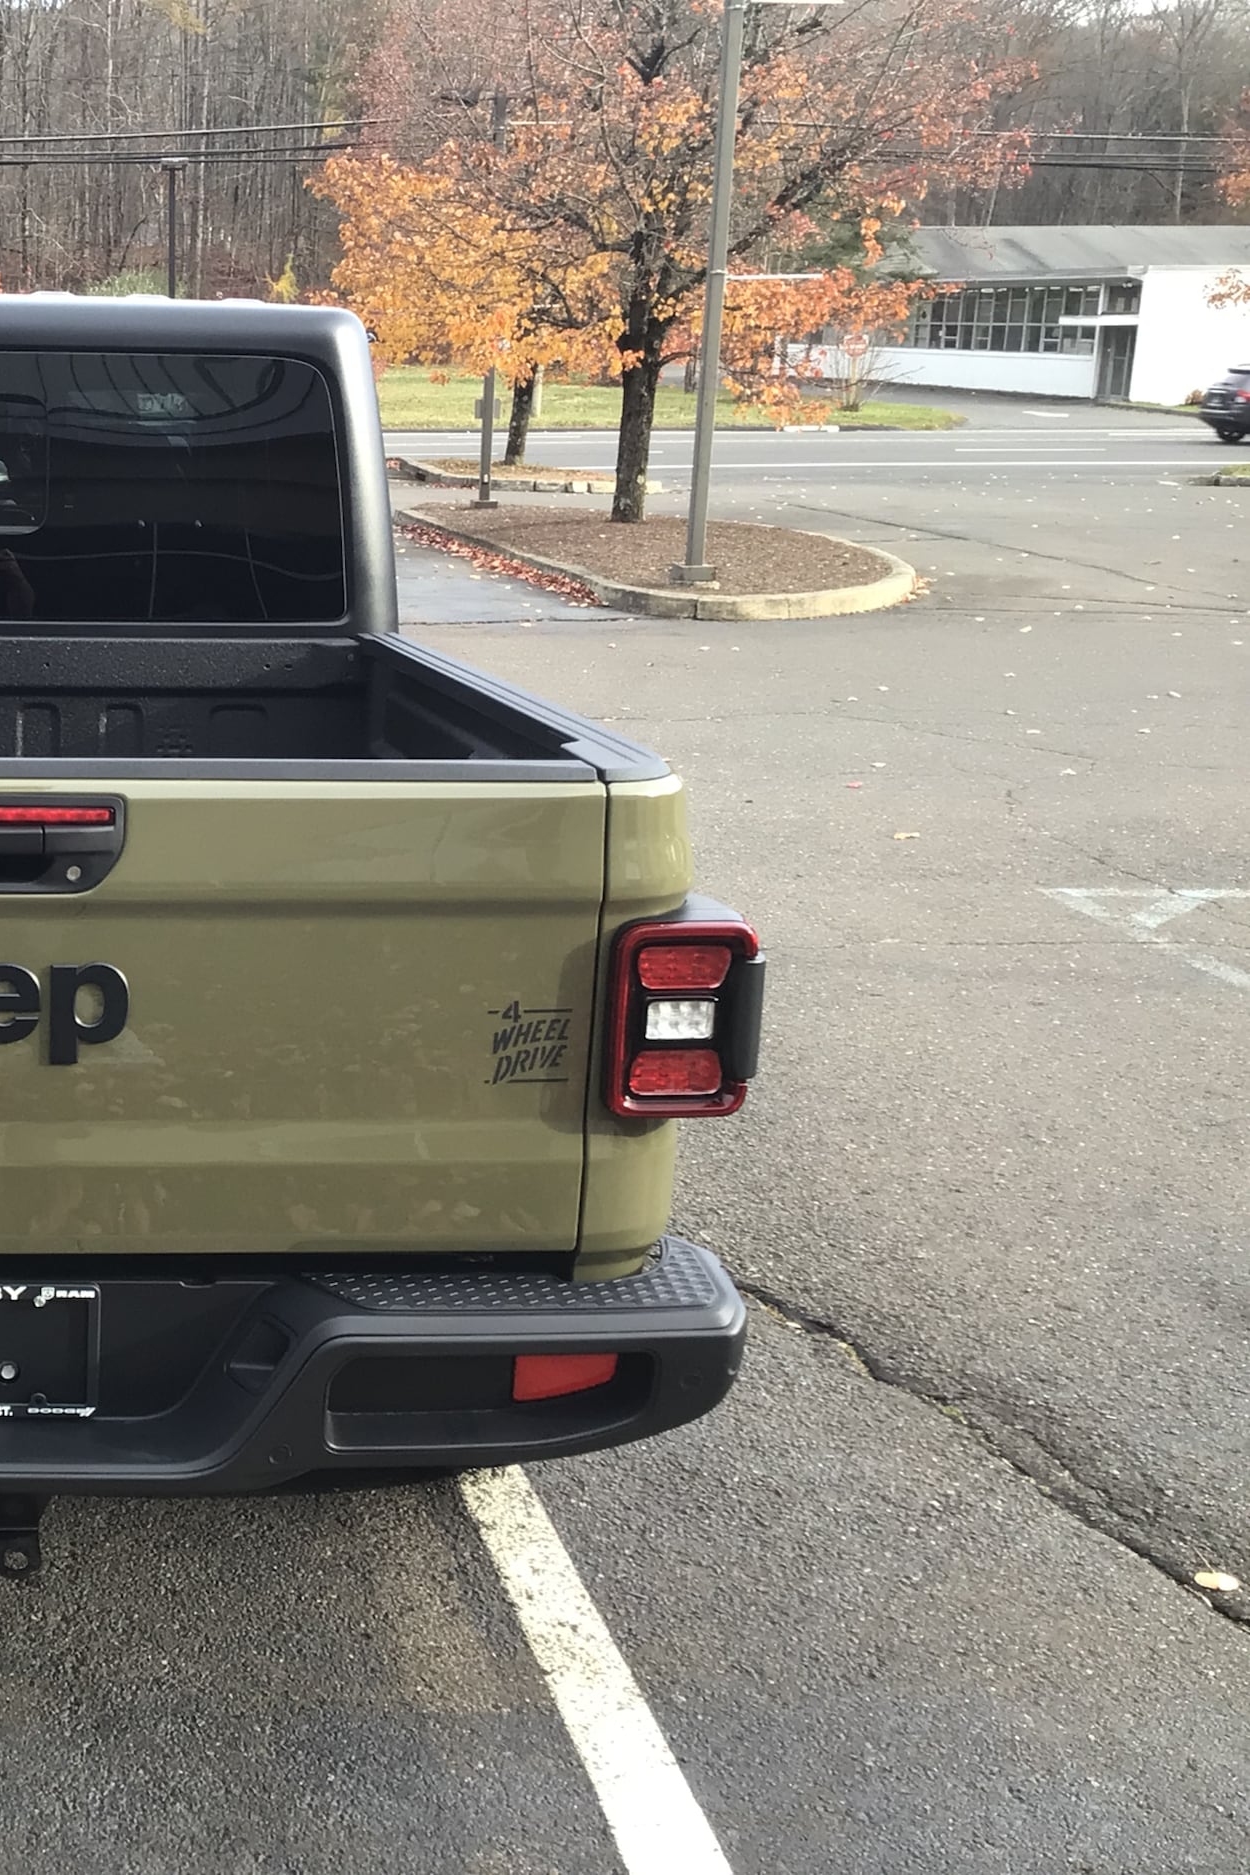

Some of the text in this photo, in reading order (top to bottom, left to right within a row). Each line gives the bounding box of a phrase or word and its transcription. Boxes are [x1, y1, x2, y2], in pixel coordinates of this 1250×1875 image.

[501, 1000, 522, 1023] 4
[492, 1018, 571, 1055] WHEEL
[491, 1044, 568, 1085] DRIVE
[55, 1289, 96, 1299] RAM
